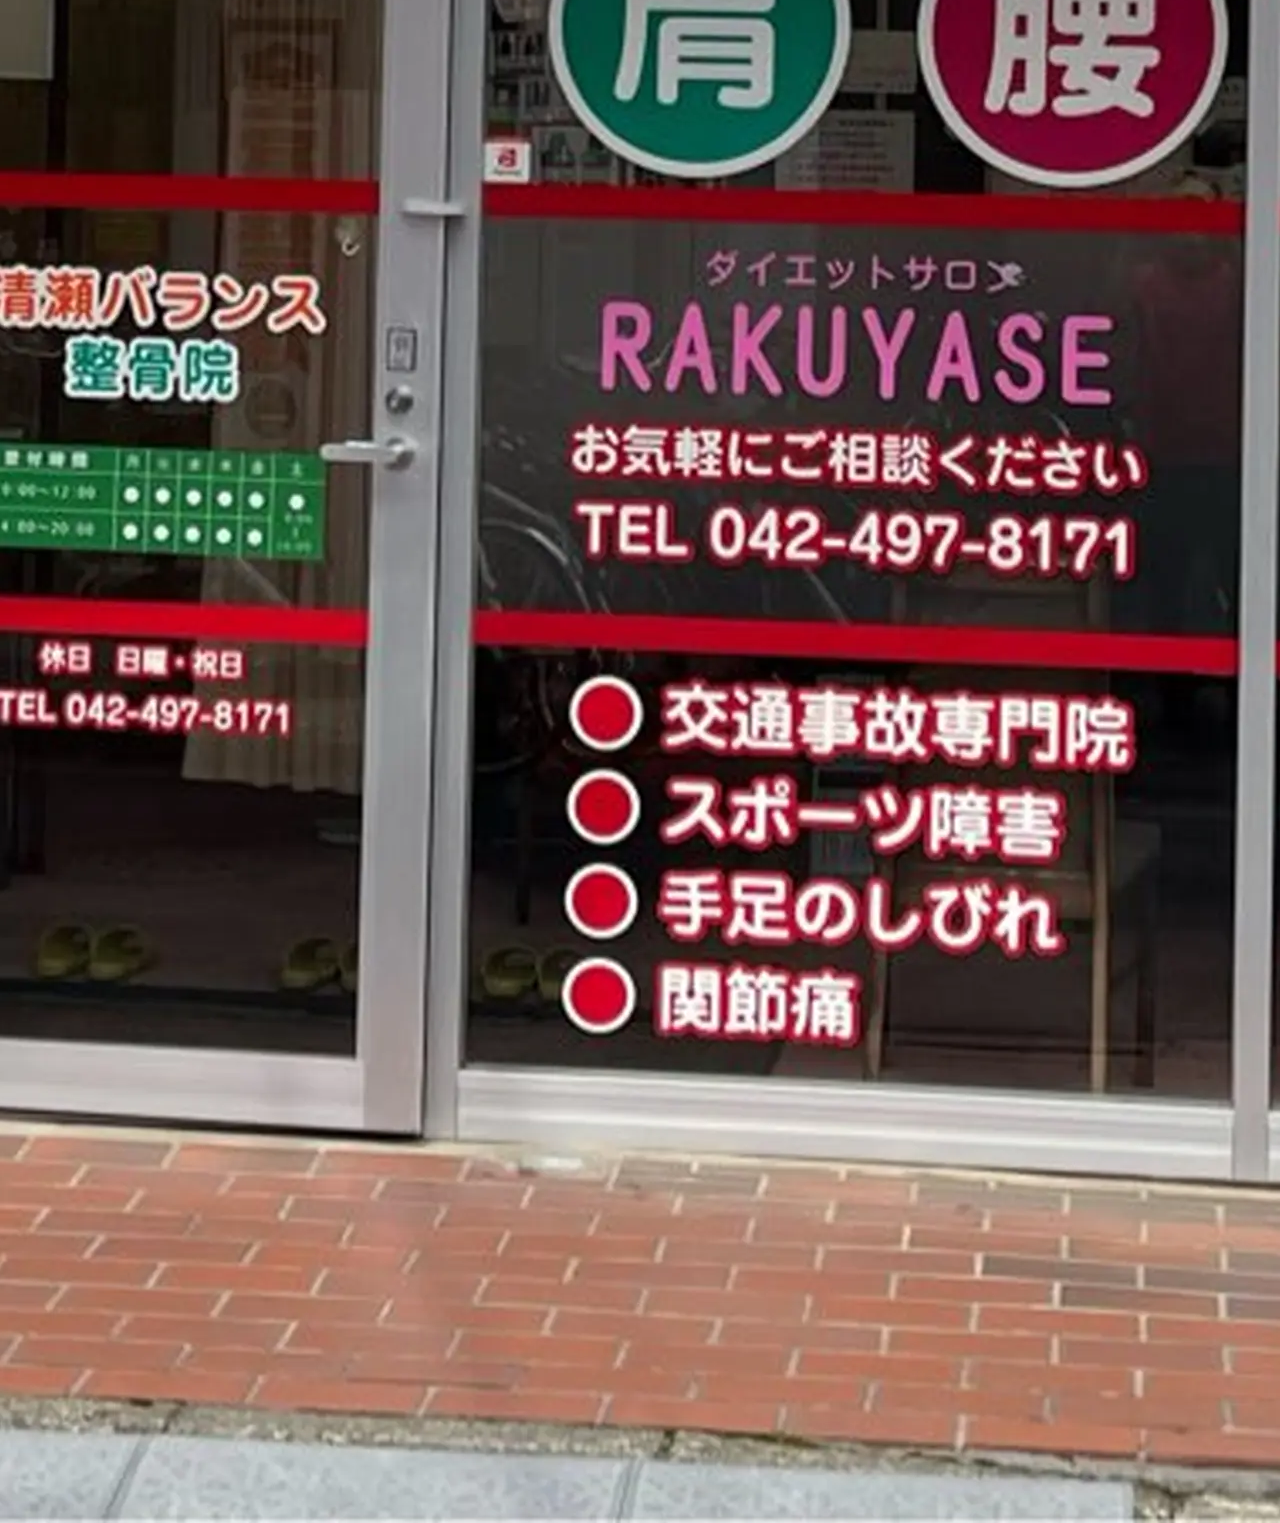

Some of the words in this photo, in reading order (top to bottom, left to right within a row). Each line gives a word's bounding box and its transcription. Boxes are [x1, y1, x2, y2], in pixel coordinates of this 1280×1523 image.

[705, 248, 1025, 295] ダイエットサロン
[65, 336, 239, 401] 整骨院
[597, 302, 1118, 407] RAKUYASE
[570, 423, 1144, 493] お気軽にご相談ください
[577, 503, 688, 559] TEL
[708, 509, 1133, 576] 042-497-8171
[39, 641, 91, 674] 休日
[116, 644, 244, 679] 日曜・祝日
[65, 692, 290, 734] 042-497-8171
[662, 684, 1135, 767] 交通事故専門院
[661, 779, 1063, 860] スポーツ障害
[660, 874, 1063, 955] 手足のしびれ
[657, 966, 859, 1041] 関節痛
